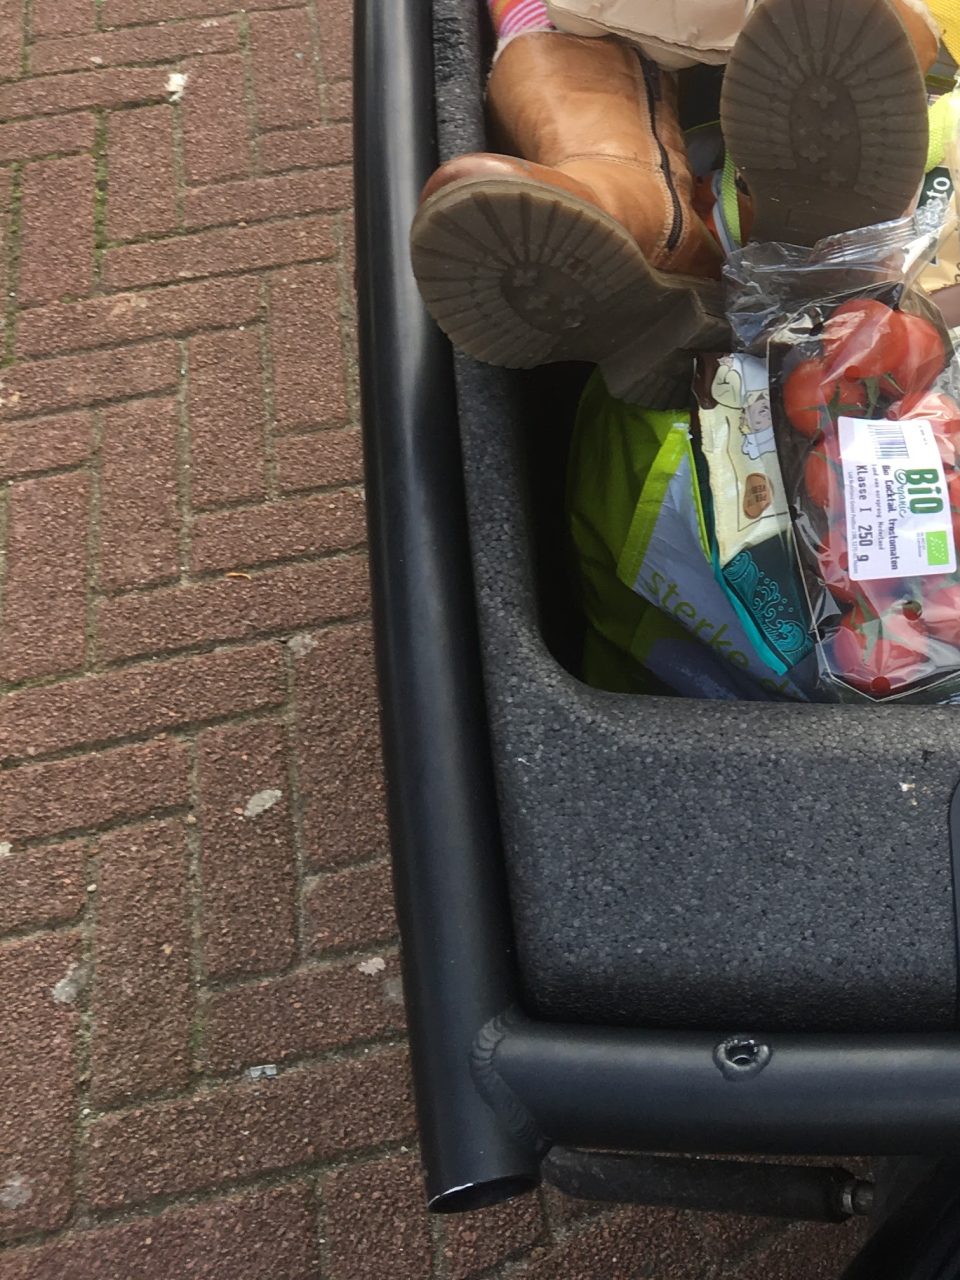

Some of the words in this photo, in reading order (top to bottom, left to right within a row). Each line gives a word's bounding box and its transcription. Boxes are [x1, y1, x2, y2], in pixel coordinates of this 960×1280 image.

[856, 465, 869, 501] Klasse
[884, 479, 898, 513] Cocktail
[858, 524, 873, 547] 250
[888, 518, 900, 571] trostomaten
[857, 554, 869, 562] g
[643, 571, 750, 669] sterke
